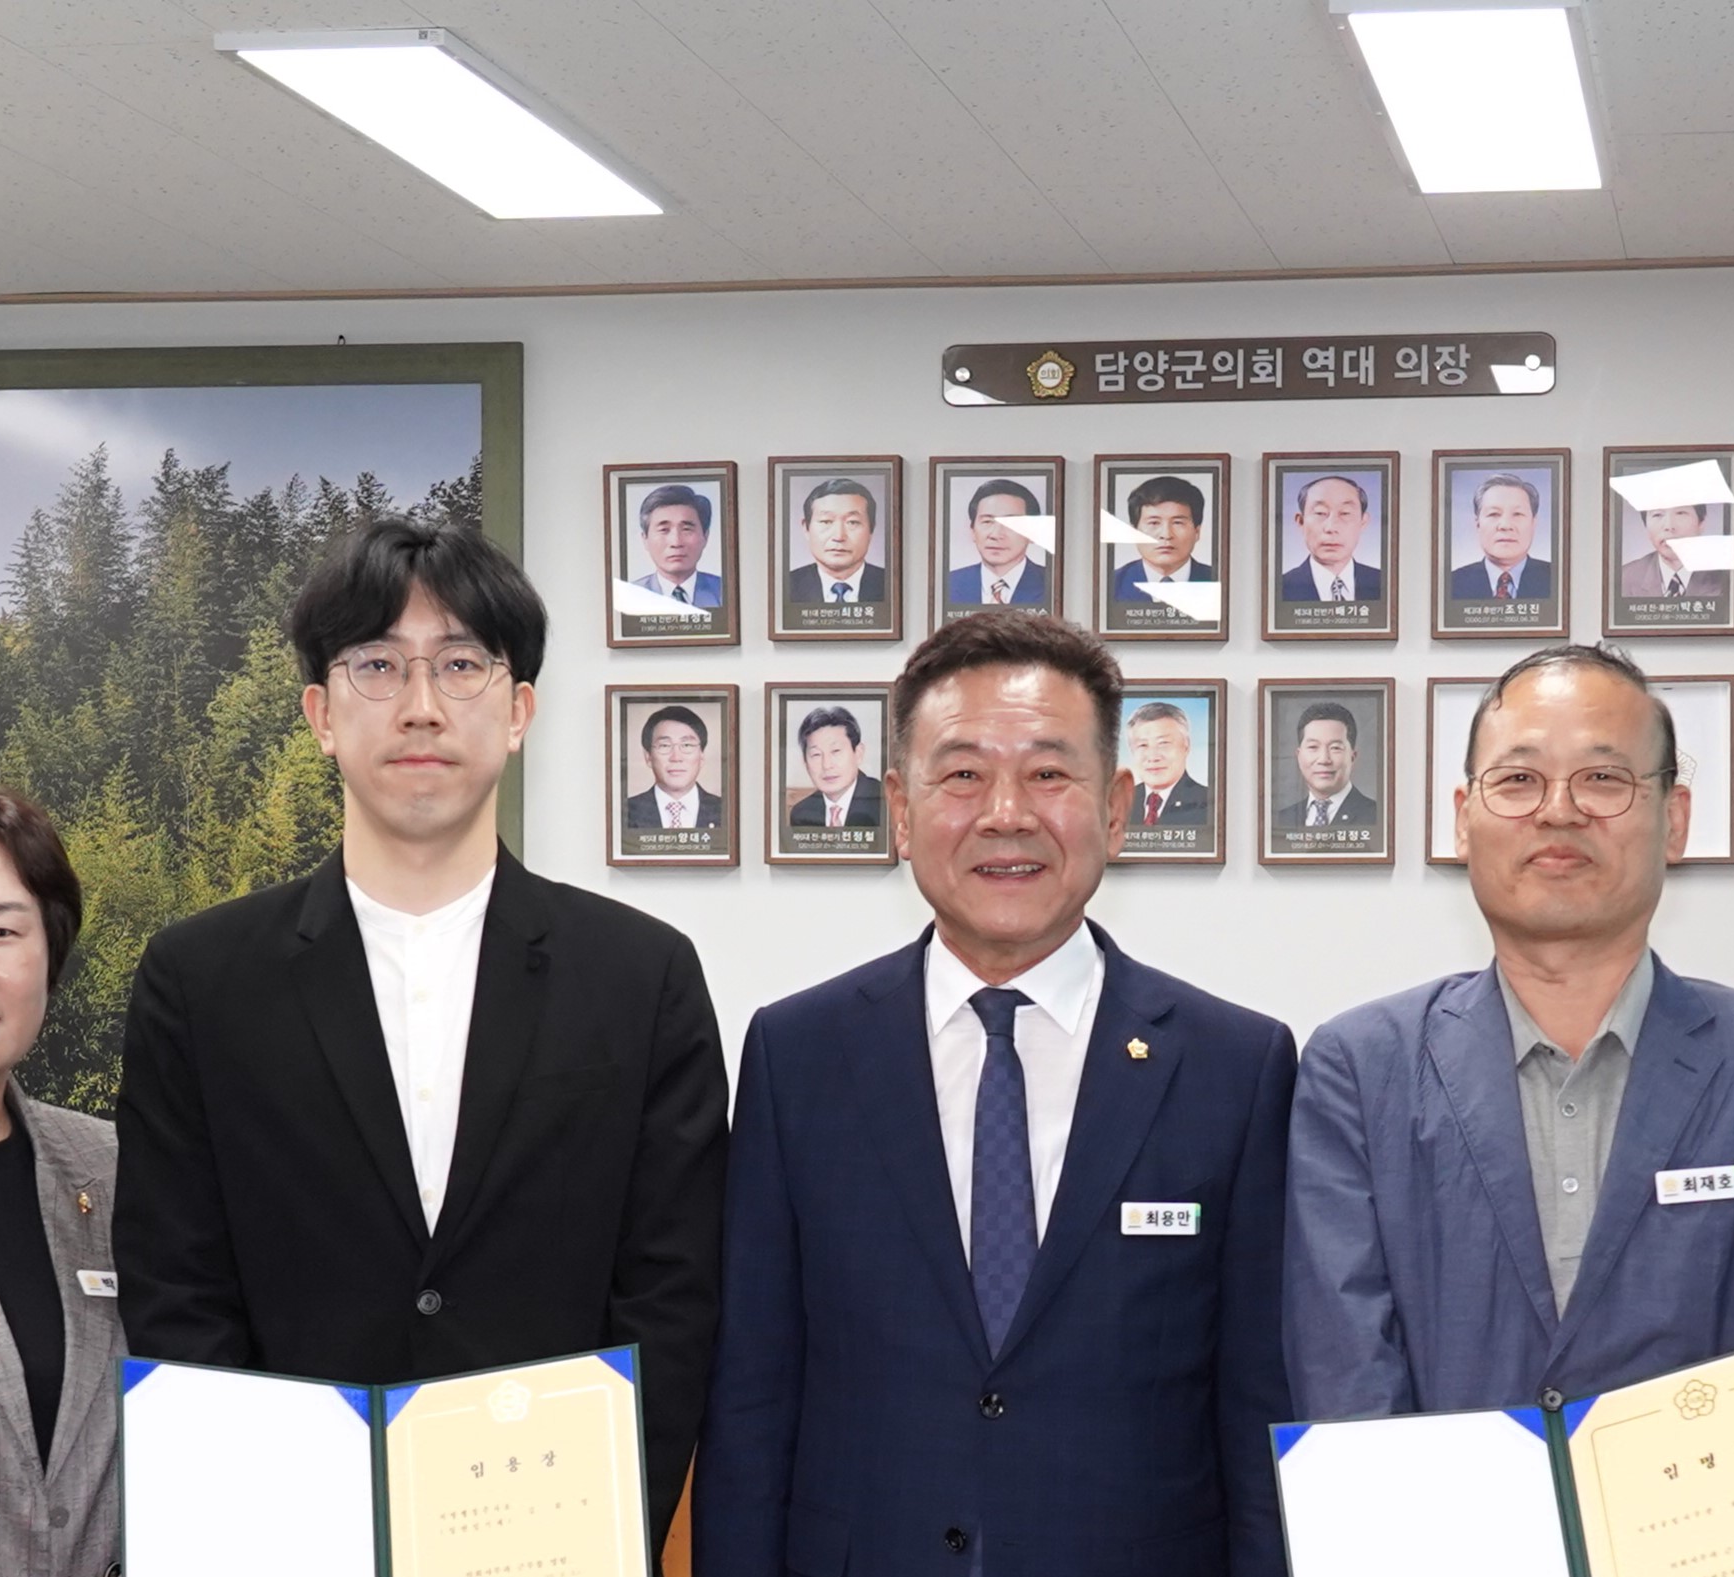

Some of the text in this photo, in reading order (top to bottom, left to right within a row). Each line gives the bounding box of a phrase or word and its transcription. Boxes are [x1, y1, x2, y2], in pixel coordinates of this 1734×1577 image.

[1095, 344, 1470, 392] 담양군의회 역대 의장
[1504, 603, 1540, 615] 조인진
[677, 832, 711, 844] 양대수
[1162, 829, 1197, 841] 김기성
[1336, 830, 1371, 842] 김정오
[1682, 1173, 1734, 1193] 최재호
[1146, 1210, 1192, 1228] 최용만
[470, 1449, 558, 1479] 임용장
